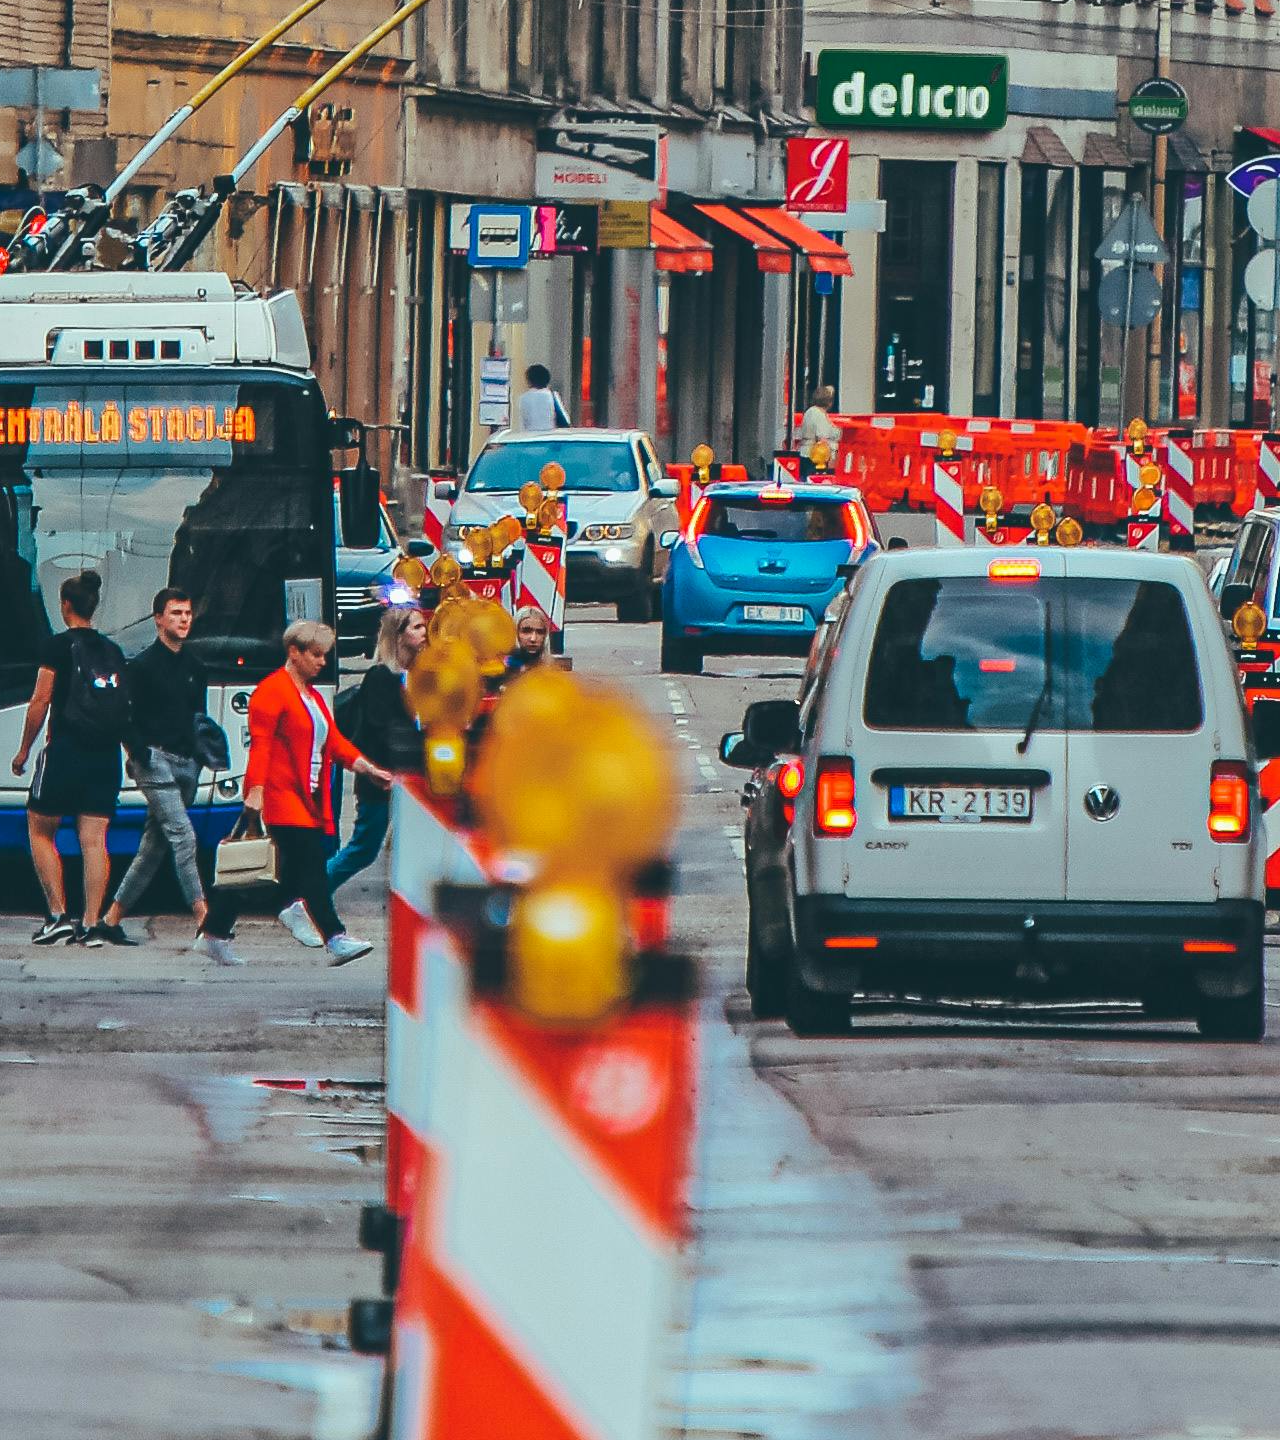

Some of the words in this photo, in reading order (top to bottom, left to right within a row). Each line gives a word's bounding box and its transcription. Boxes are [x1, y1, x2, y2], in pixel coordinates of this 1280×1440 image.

[832, 71, 990, 119] delicio
[128, 404, 257, 444] STACIJA
[909, 790, 1026, 814] KR-2139
[865, 841, 909, 851] CADDY
